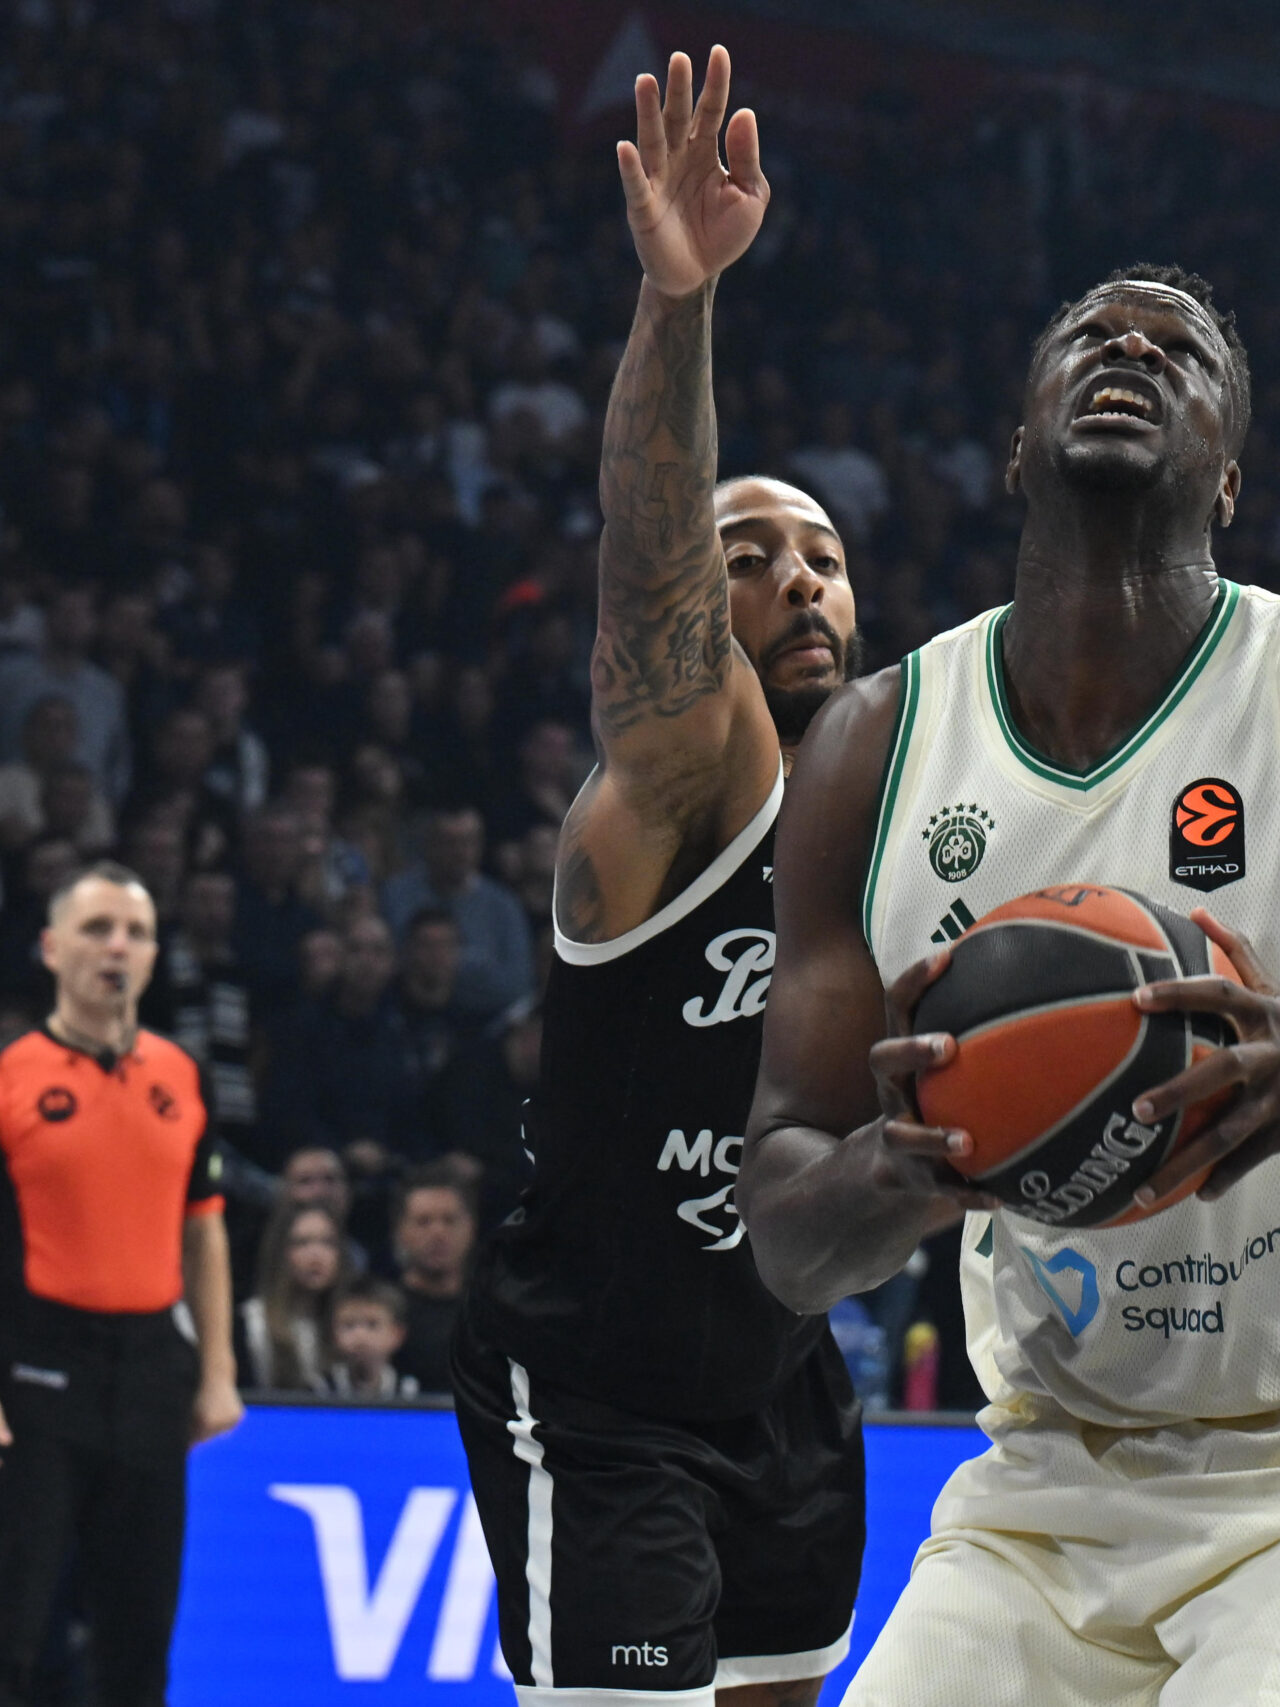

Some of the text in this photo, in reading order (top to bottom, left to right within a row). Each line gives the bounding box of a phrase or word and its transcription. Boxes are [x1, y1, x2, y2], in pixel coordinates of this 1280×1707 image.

[948, 869, 967, 880] 1908
[1175, 862, 1240, 877] ETIHAD
[1018, 1111, 1164, 1224] LDING
[1121, 1301, 1225, 1340] squad
[267, 1483, 514, 1682] VI
[611, 1641, 669, 1667] mts
